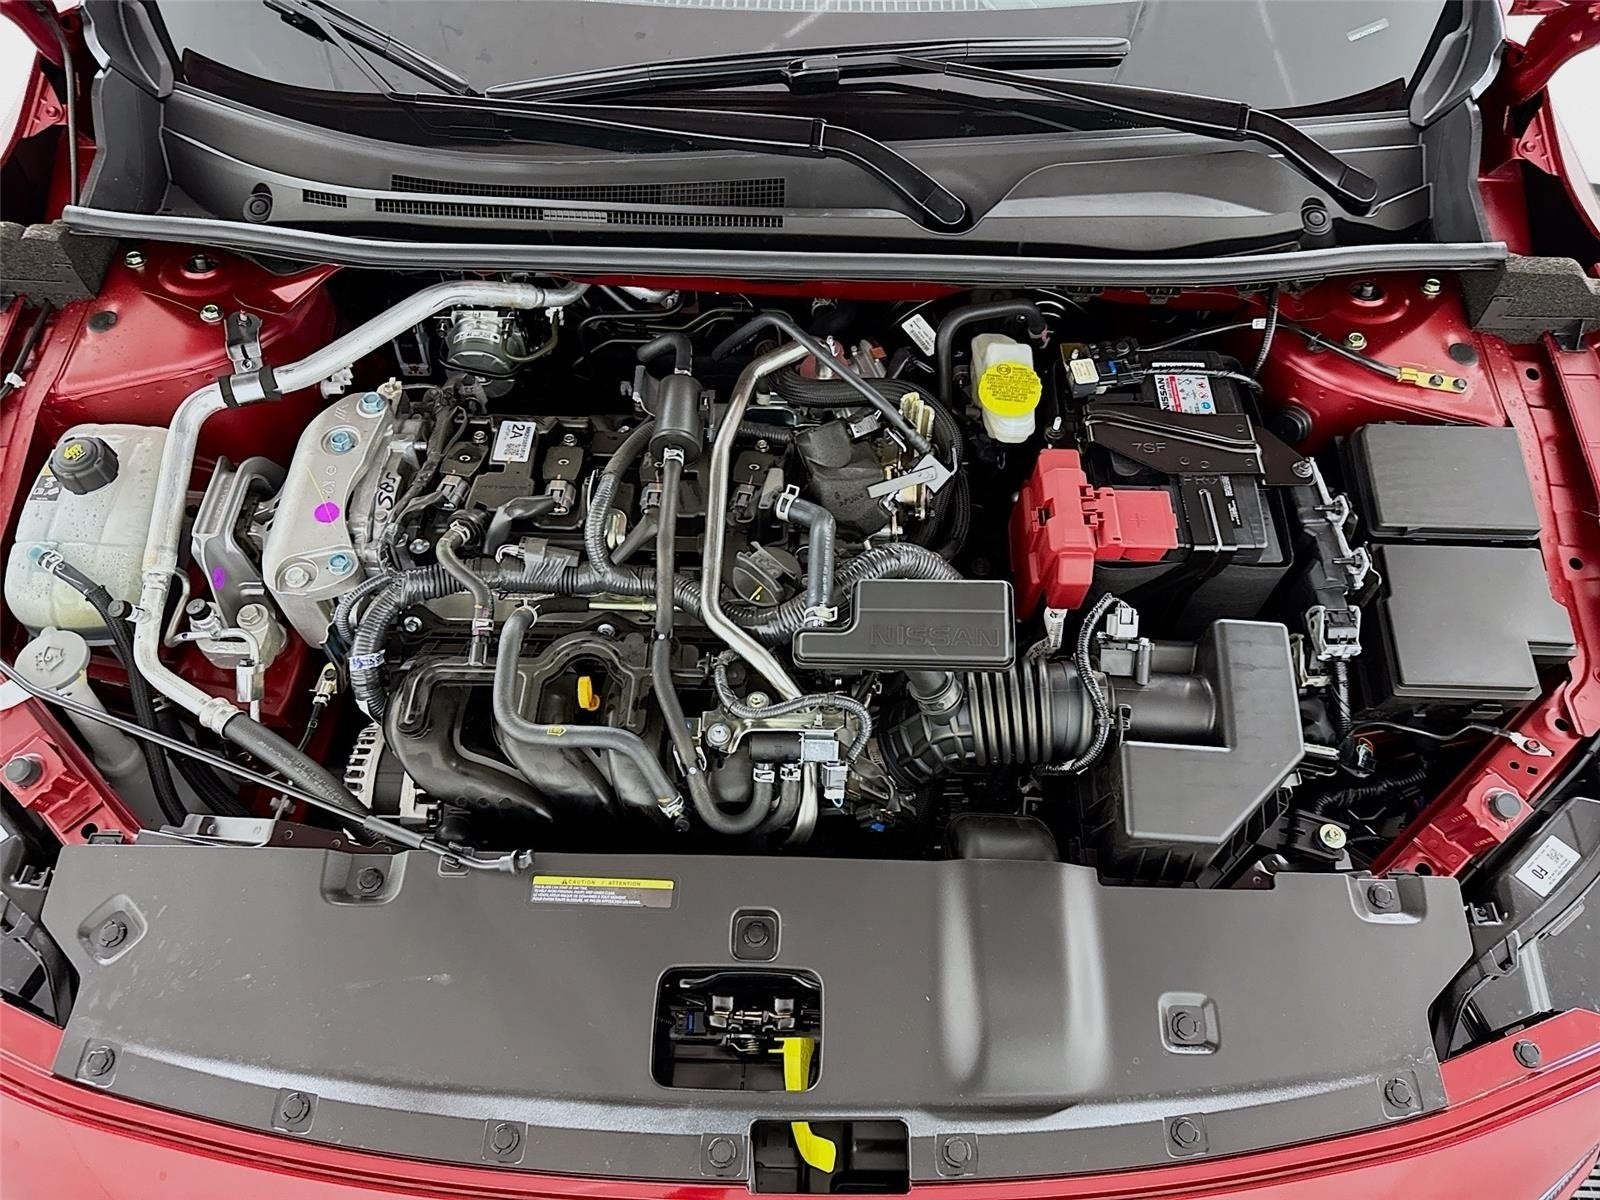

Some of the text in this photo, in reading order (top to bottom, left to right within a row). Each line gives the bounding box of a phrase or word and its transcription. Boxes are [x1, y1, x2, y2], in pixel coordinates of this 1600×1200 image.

[510, 424, 526, 439] 2A
[1132, 442, 1166, 453] 7SF
[871, 625, 1000, 648] NISSAN
